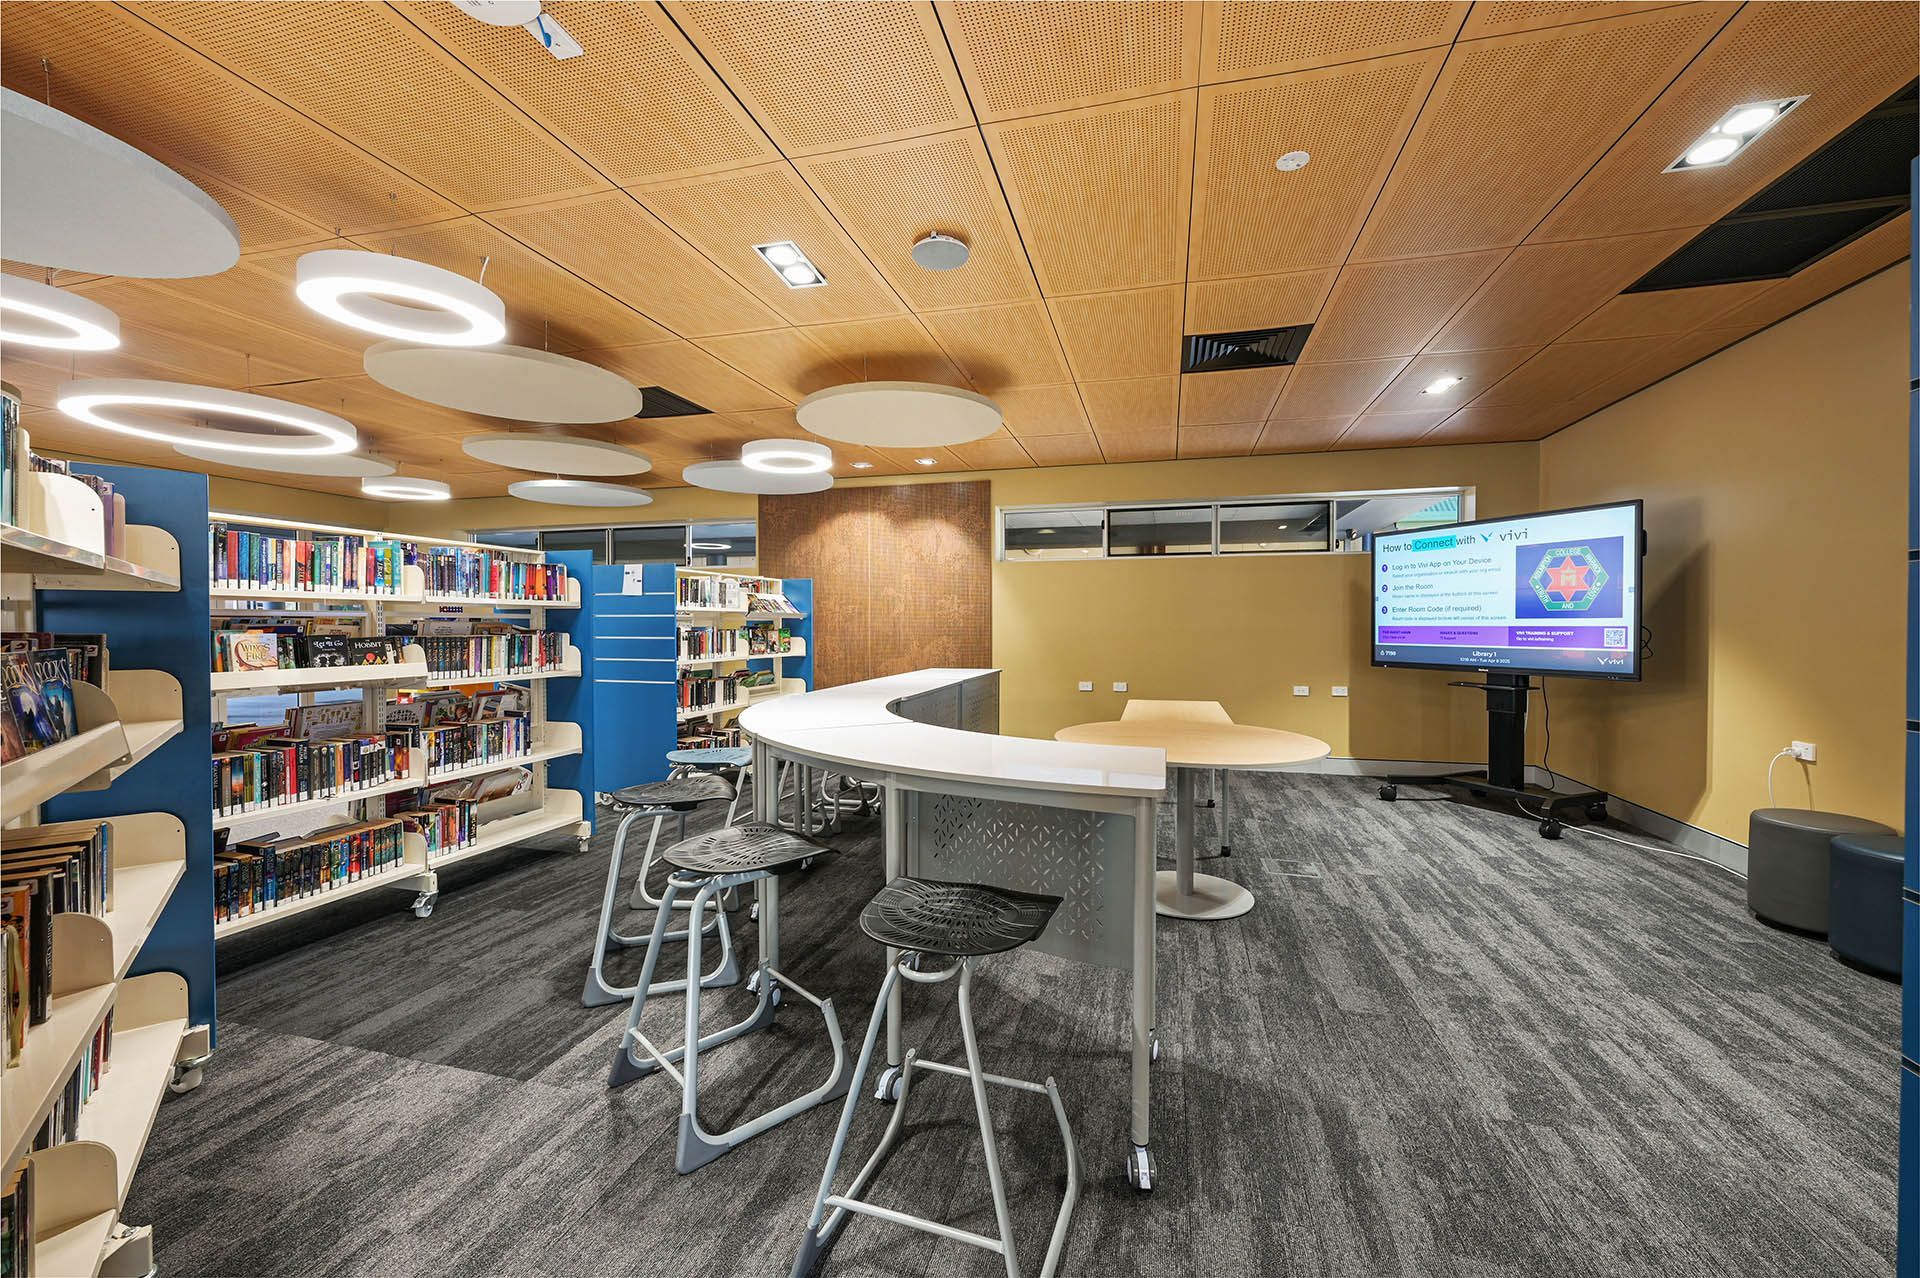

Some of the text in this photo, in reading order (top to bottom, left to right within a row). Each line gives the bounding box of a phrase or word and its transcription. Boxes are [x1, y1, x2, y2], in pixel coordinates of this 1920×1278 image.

[1382, 528, 1528, 553] How to Connect with vivi
[1429, 561, 1442, 569] App
[1469, 557, 1492, 565] Device
[1452, 605, 1482, 613] required)
[240, 643, 271, 652] WINGS
[354, 641, 382, 649] HOBBIT
[1472, 650, 1493, 658] Library
